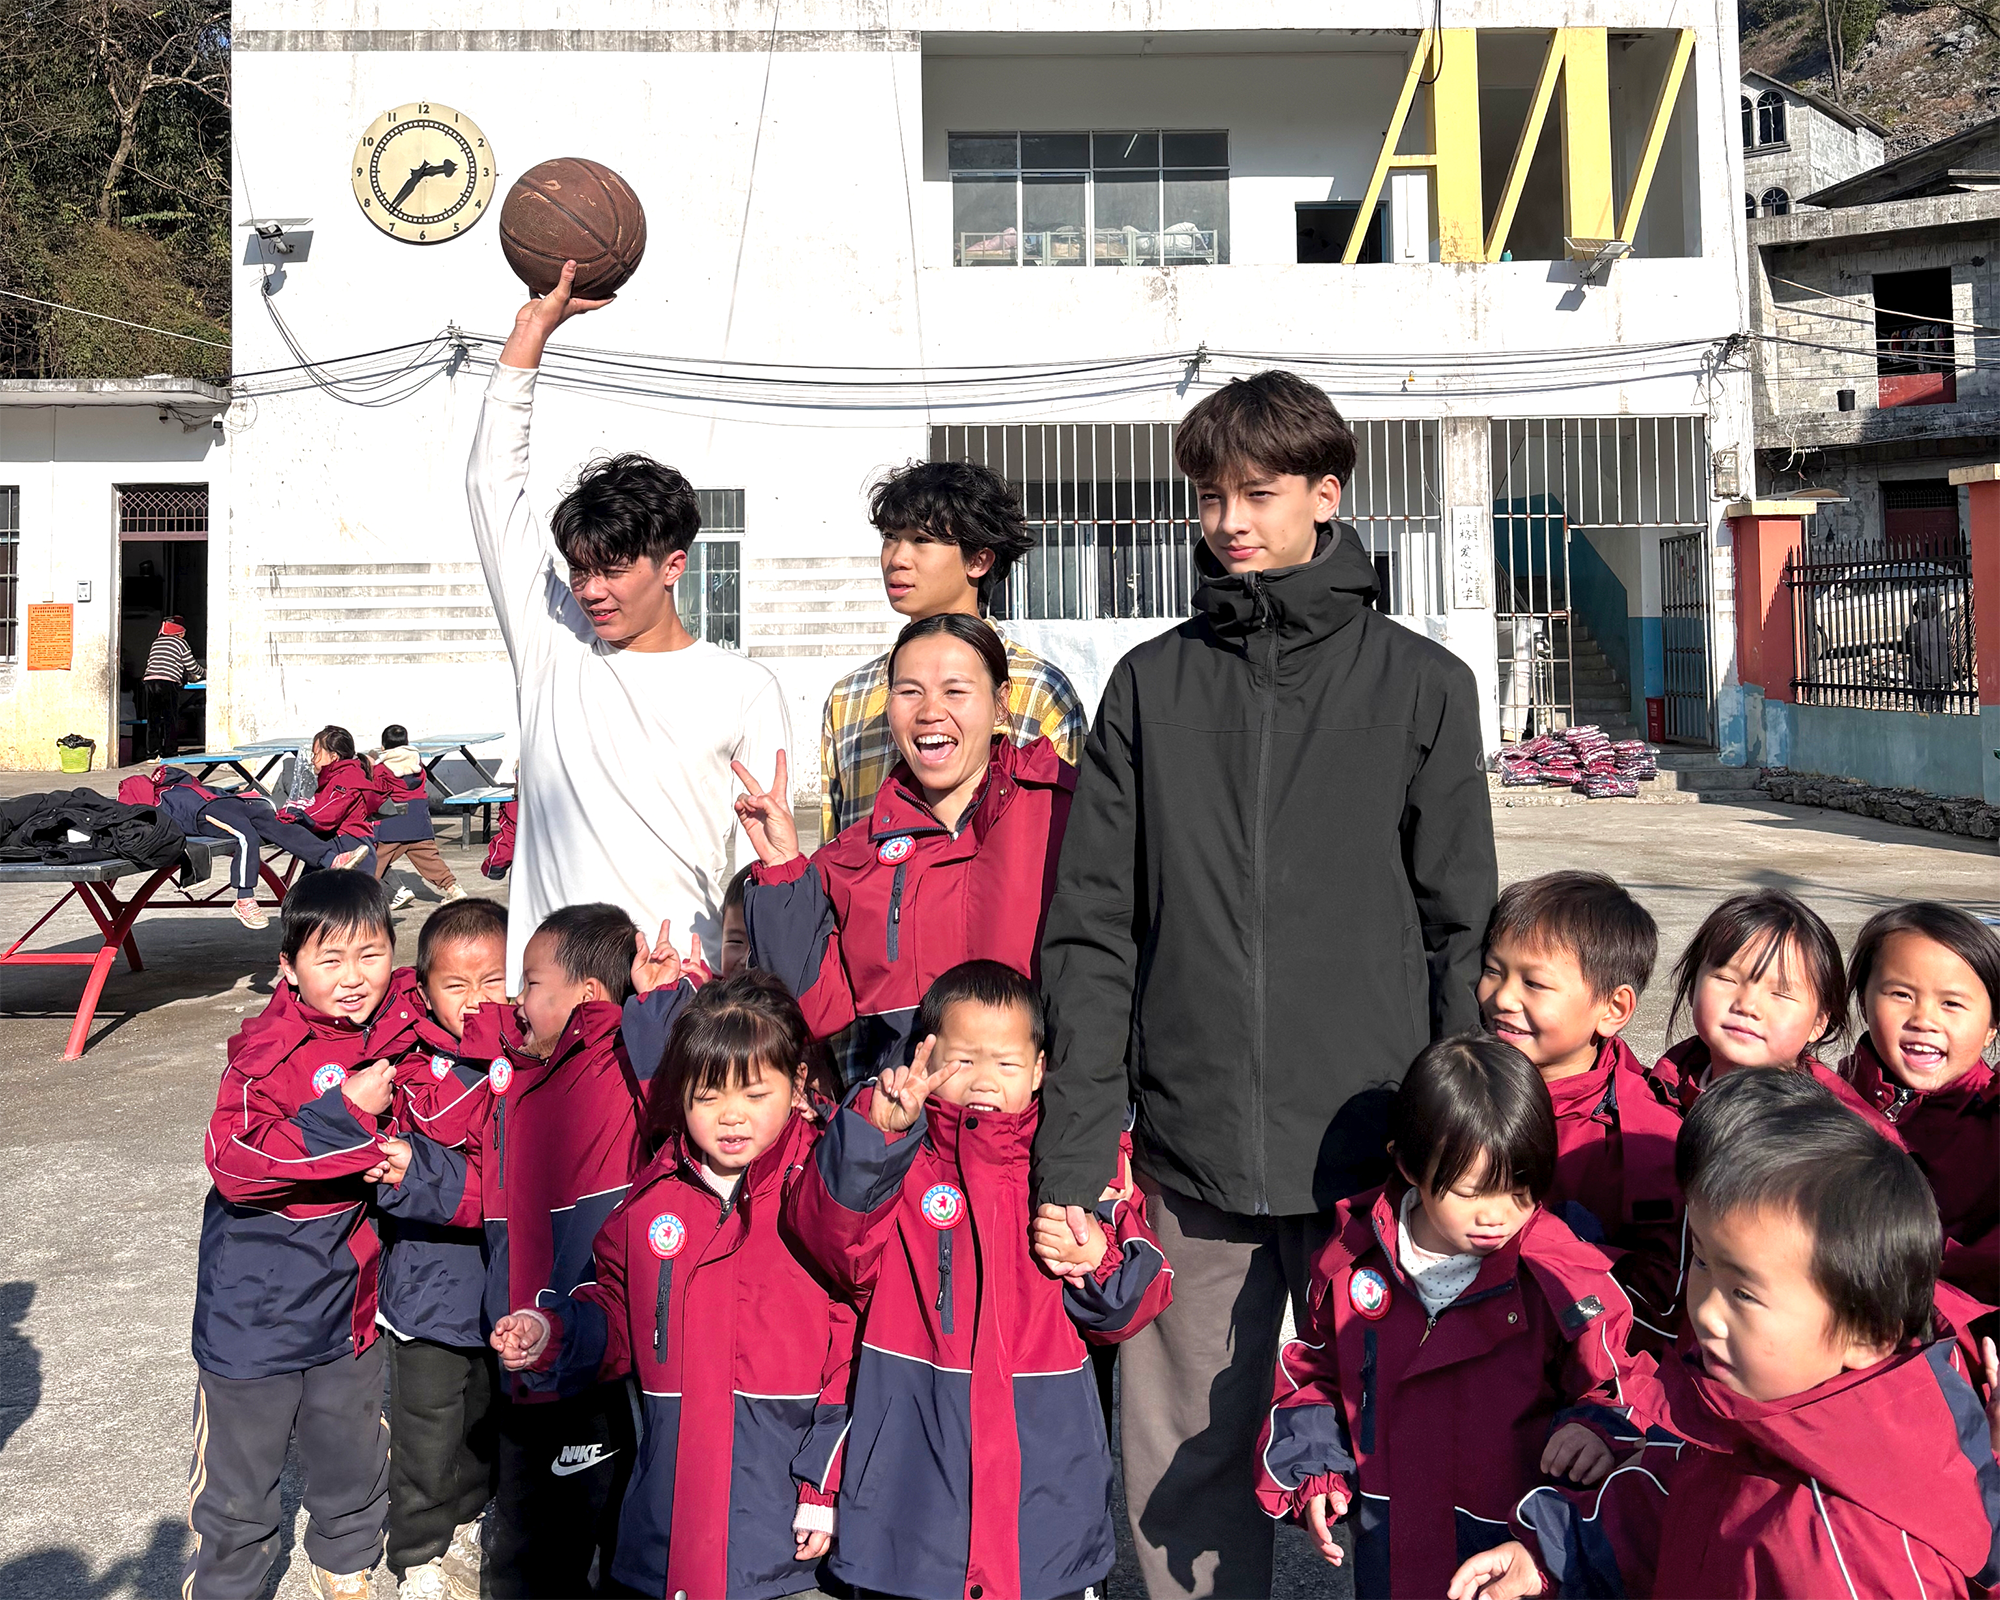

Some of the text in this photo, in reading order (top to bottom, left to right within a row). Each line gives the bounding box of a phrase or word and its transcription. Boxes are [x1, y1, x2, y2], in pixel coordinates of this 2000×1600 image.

[418, 104, 430, 114] 12
[388, 112, 397, 122] 11
[454, 113, 459, 123] 1
[362, 137, 374, 146] 10
[477, 138, 485, 147] 2
[356, 167, 363, 177] 9
[483, 168, 489, 177] 3
[364, 198, 371, 208] 8
[474, 199, 482, 209] 4
[388, 222, 396, 232] 7
[453, 222, 459, 232] 5
[419, 231, 426, 240] 6
[559, 1443, 603, 1464] NIKE
